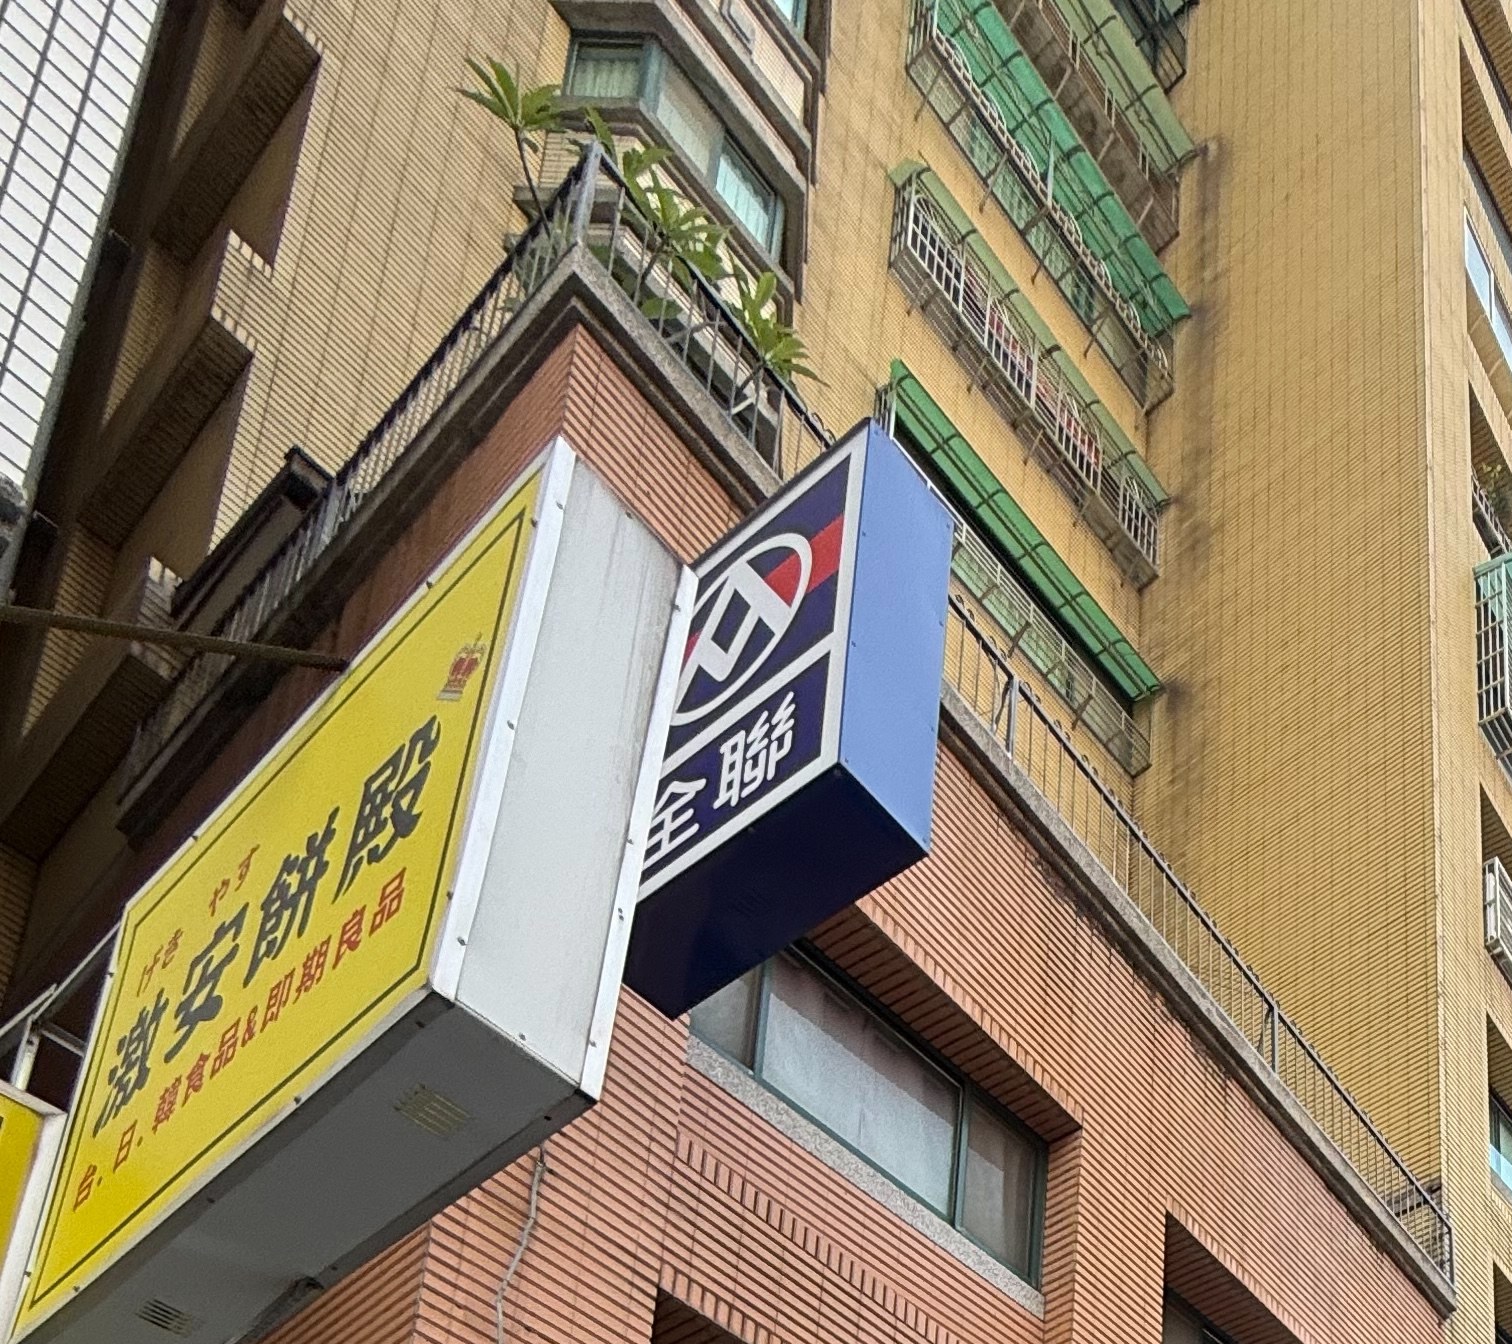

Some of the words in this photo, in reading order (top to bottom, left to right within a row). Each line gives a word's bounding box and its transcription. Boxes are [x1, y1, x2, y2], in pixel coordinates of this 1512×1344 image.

[93, 714, 442, 1139] 激安餅殿
[642, 691, 796, 870] 全聯
